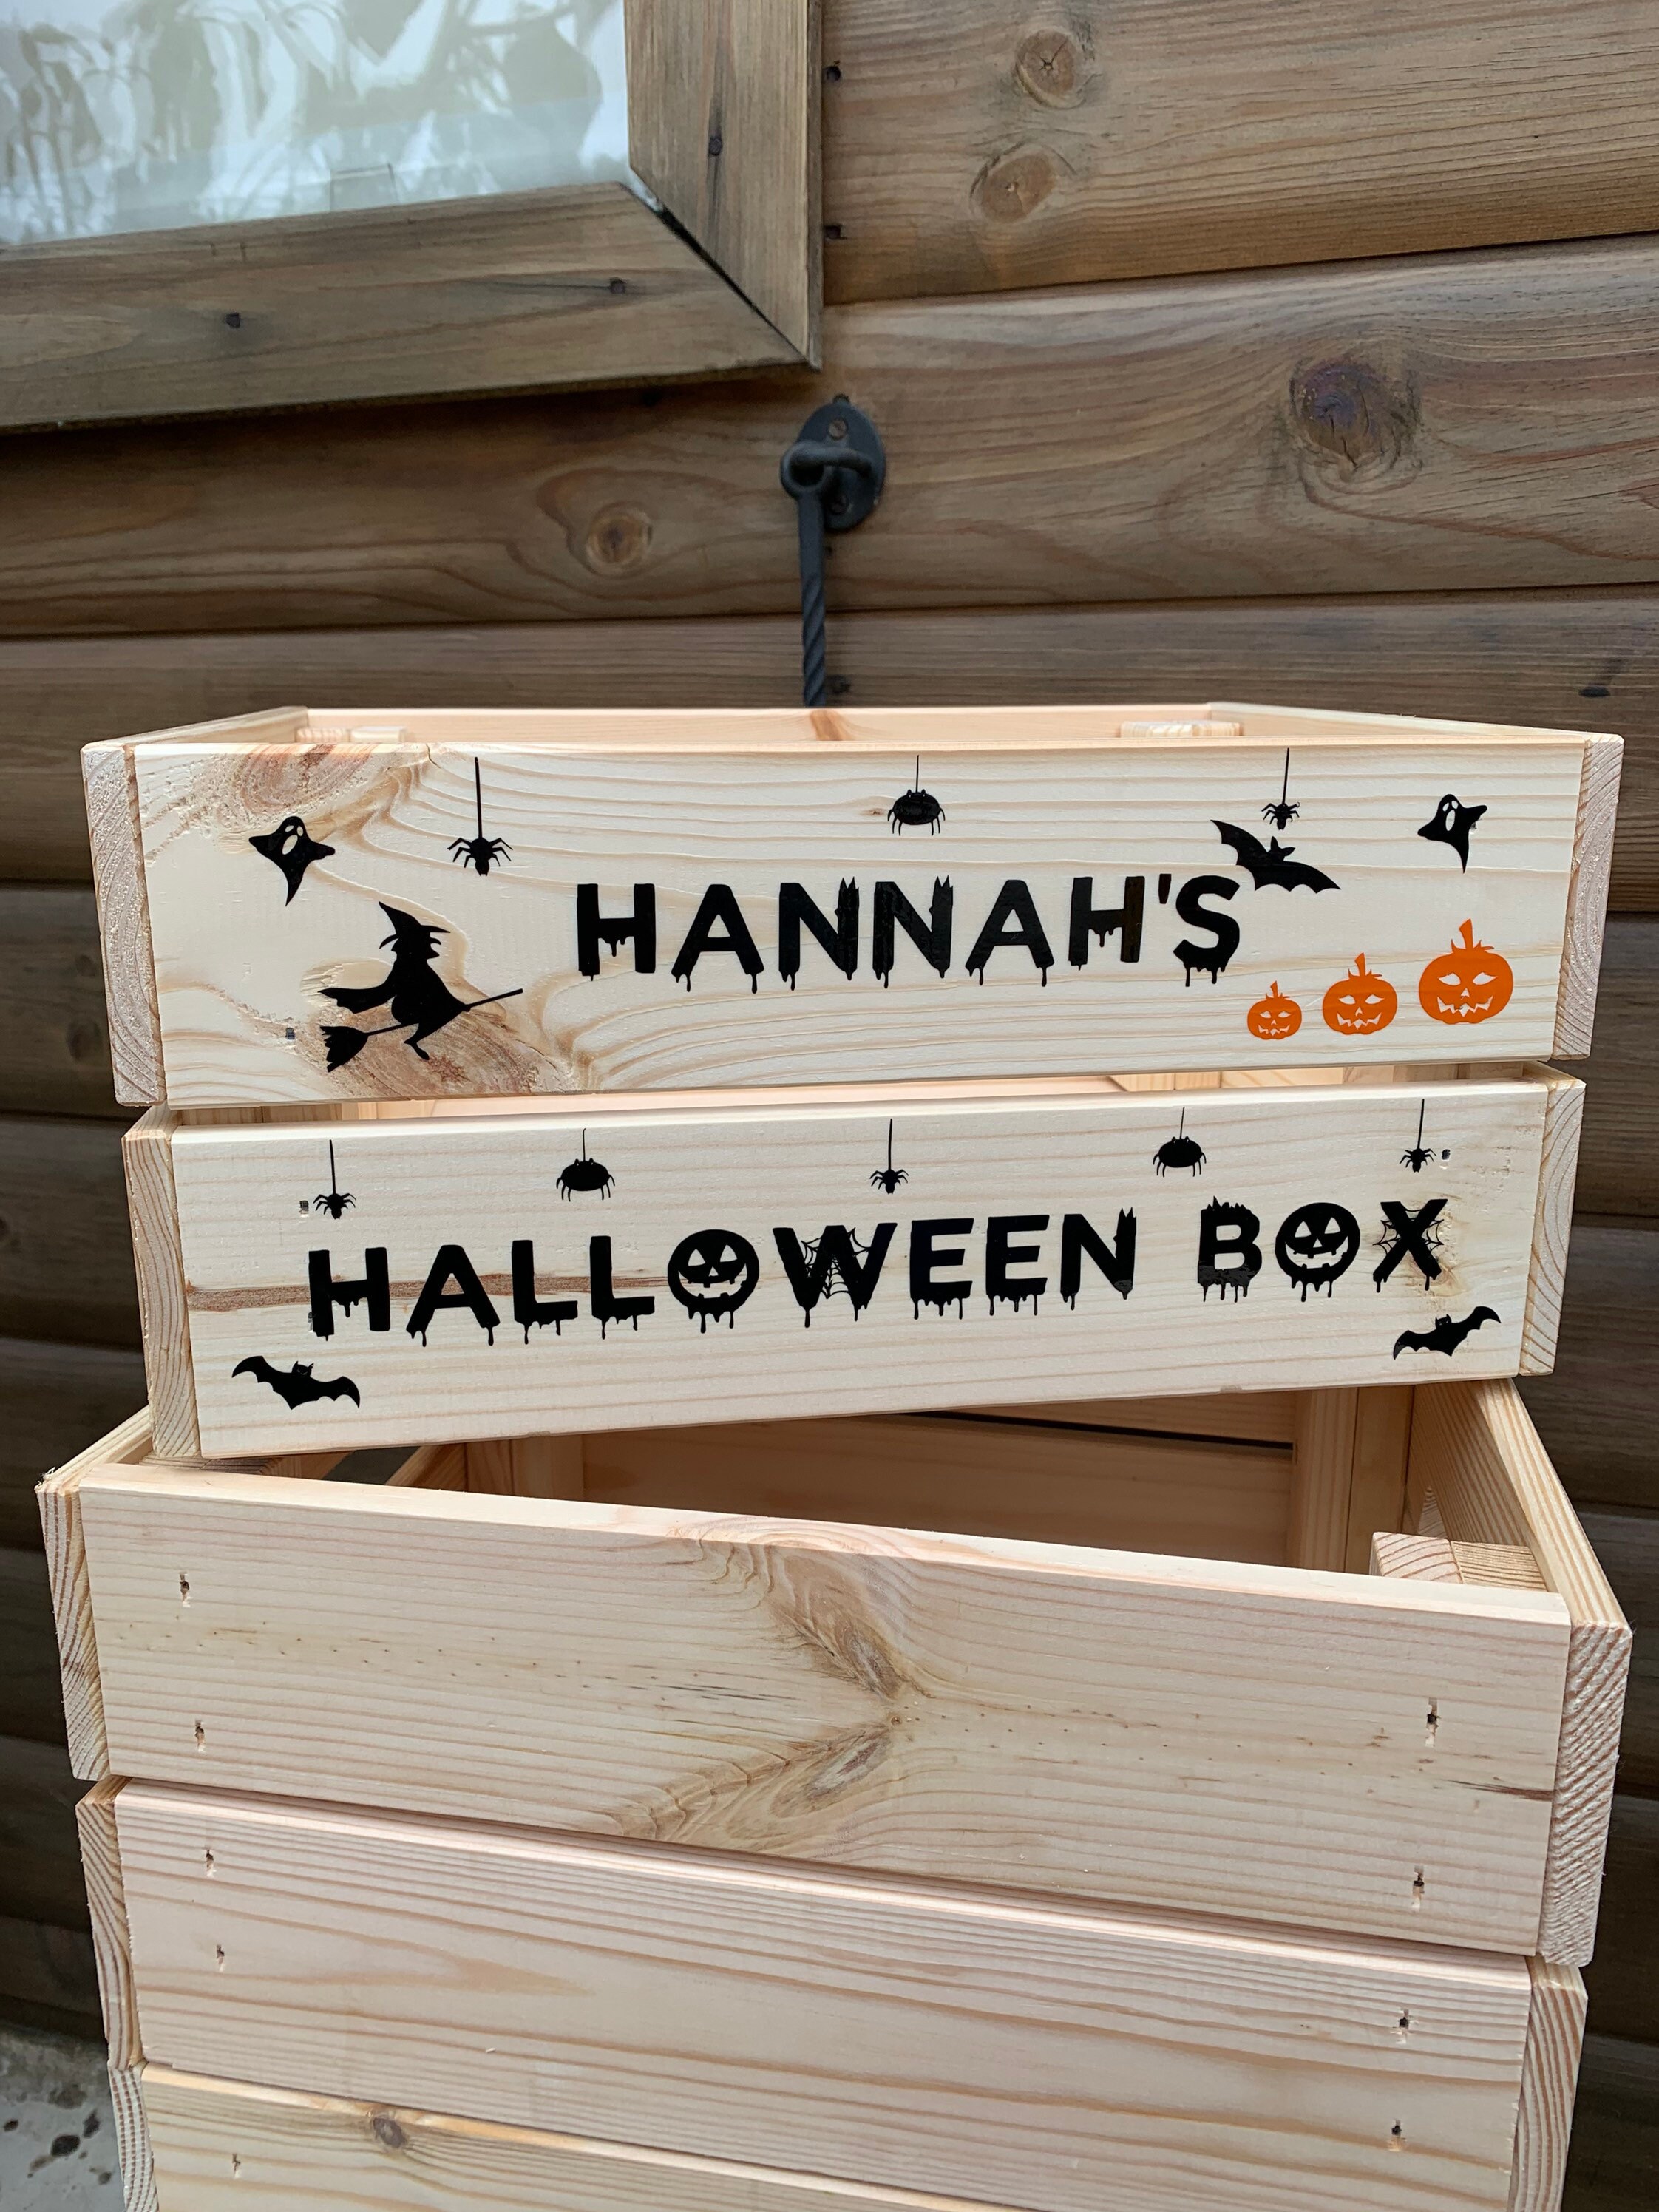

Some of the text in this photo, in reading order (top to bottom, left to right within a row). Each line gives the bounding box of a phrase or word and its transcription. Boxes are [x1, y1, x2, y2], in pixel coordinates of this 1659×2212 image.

[576, 874, 1241, 995] HANNAH'S
[308, 1196, 1448, 1347] HALLOWEEN BOX
